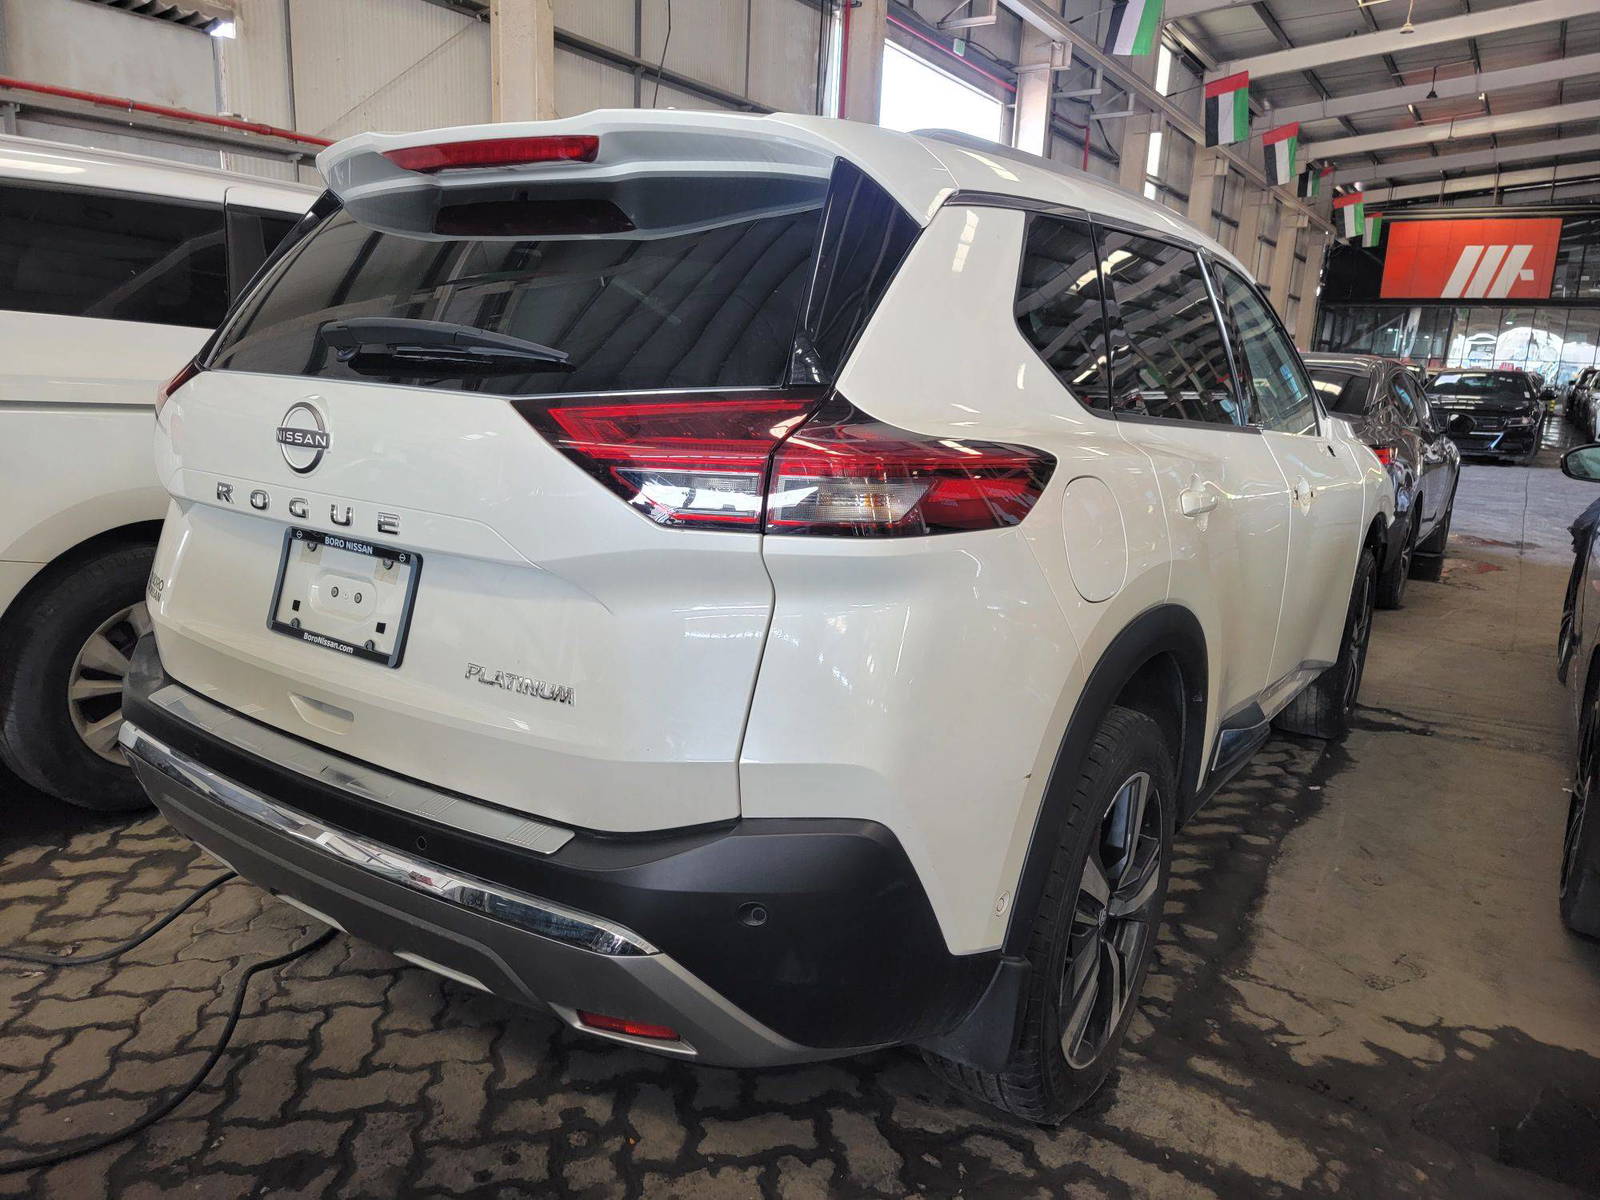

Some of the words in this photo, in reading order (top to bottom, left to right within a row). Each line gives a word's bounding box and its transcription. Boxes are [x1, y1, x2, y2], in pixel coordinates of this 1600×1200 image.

[275, 429, 328, 447] NISSAN
[216, 481, 400, 535] ROGUE
[324, 536, 345, 549] BORO
[346, 541, 374, 555] NISSAN
[303, 632, 354, 654] BoroNissan.com
[464, 662, 575, 706] PLATINUM
